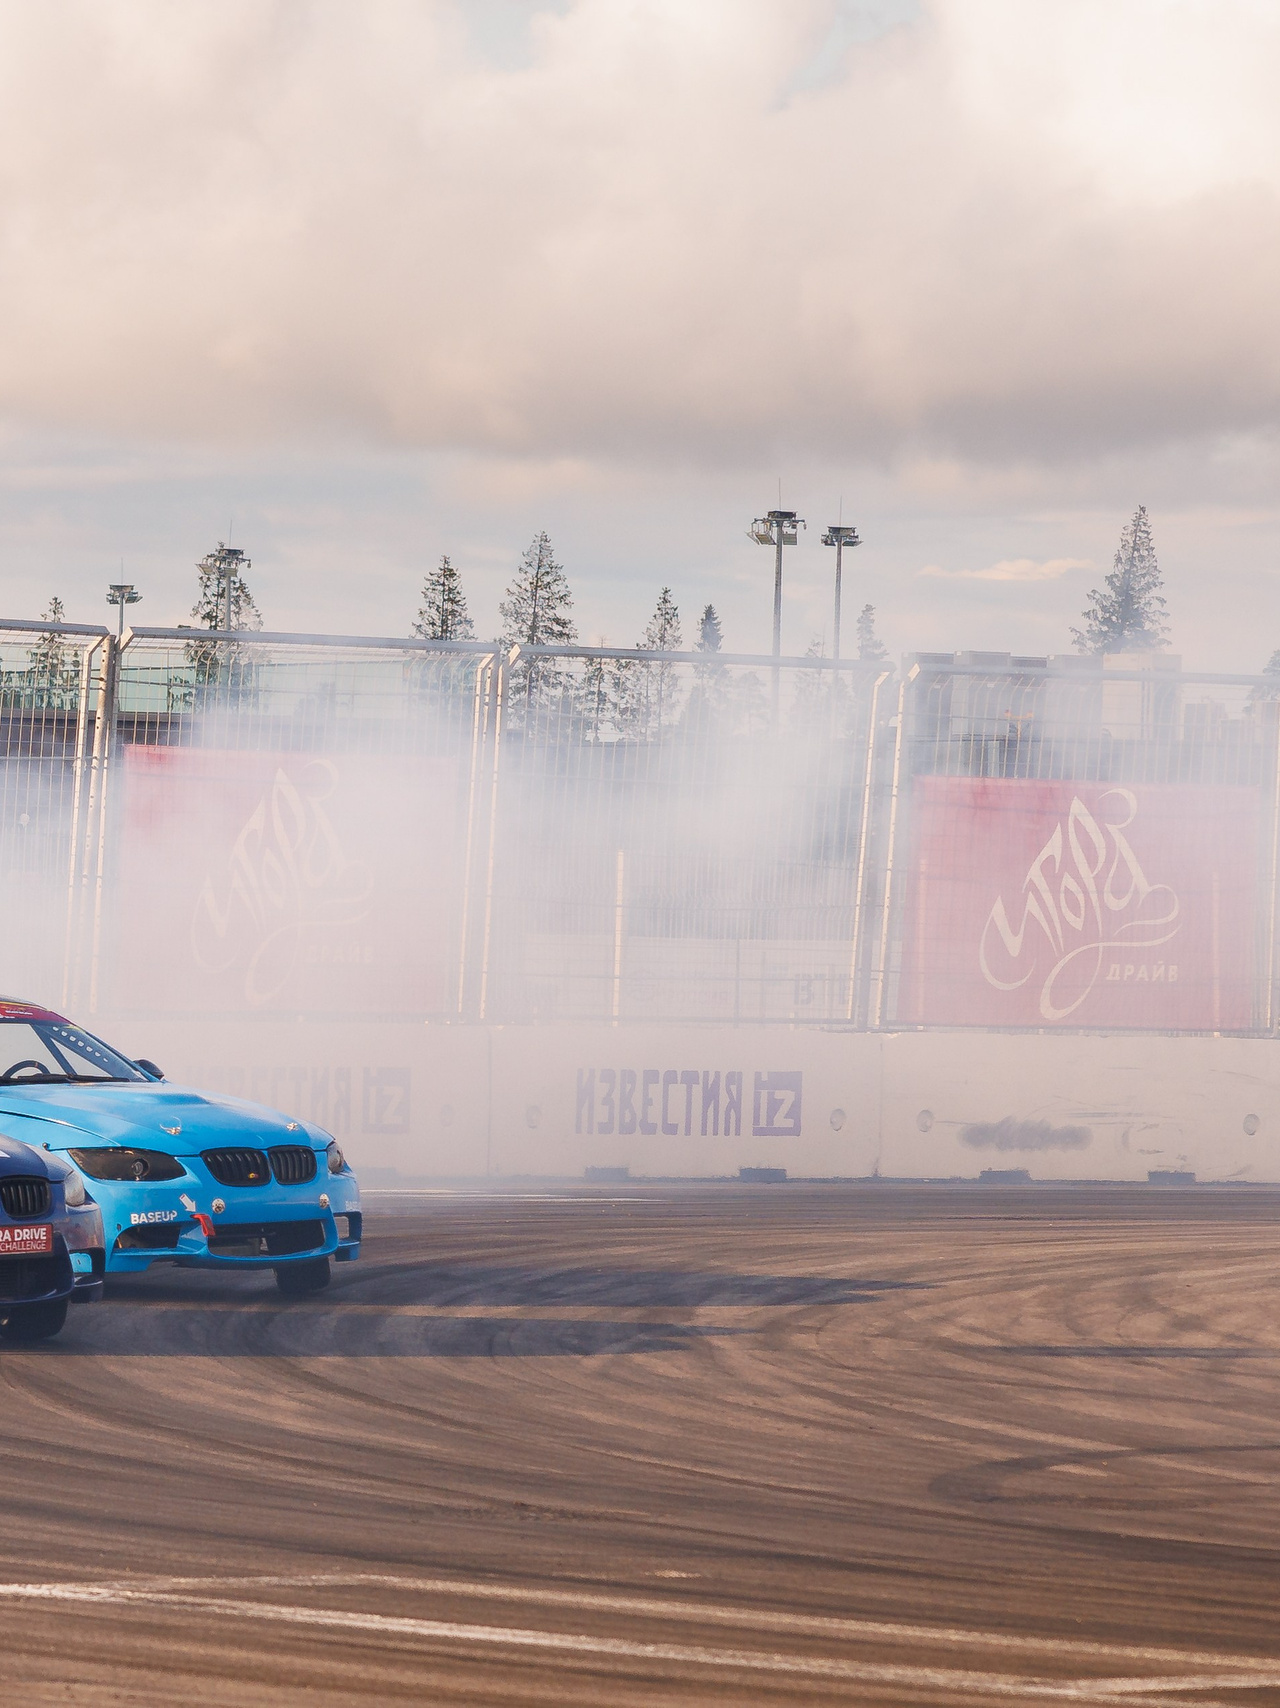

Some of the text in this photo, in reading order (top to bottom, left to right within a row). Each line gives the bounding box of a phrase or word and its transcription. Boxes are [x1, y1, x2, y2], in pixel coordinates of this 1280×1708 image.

[1105, 961, 1180, 982] ДРАЙВ
[575, 1068, 743, 1137] ИЗВЕСТИЯ
[130, 1209, 178, 1225] BASEUP
[13, 1227, 47, 1241] DRIVE
[0, 1240, 47, 1252] CHALLENGE
